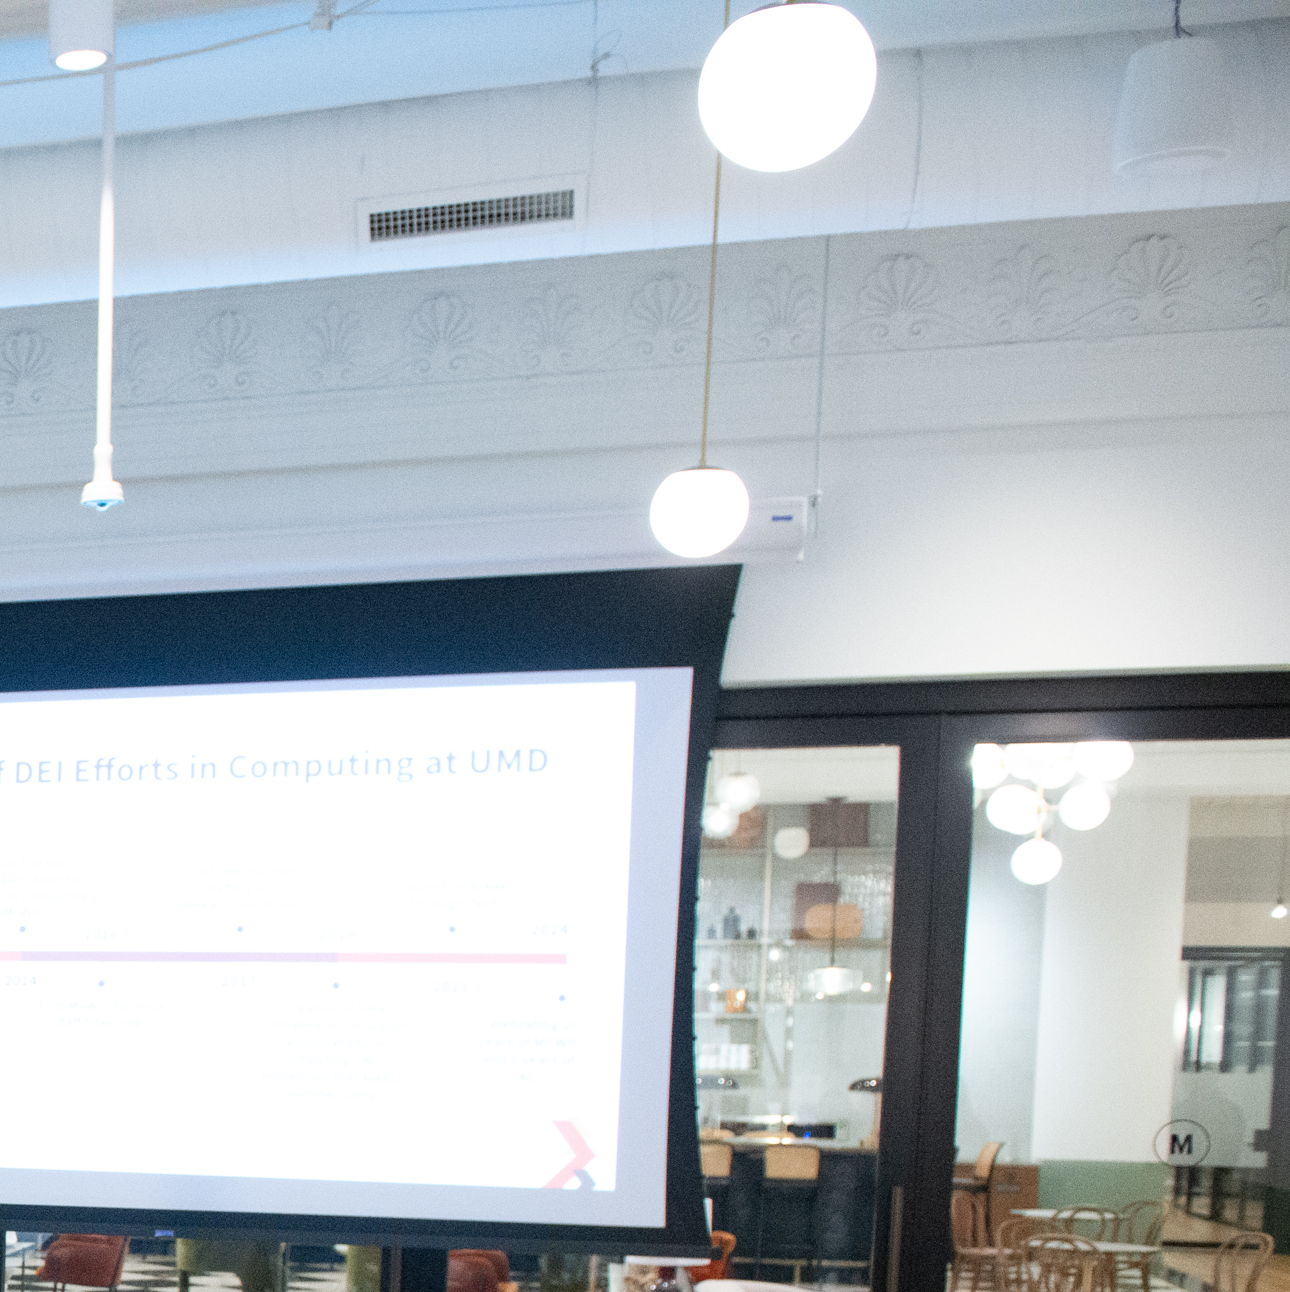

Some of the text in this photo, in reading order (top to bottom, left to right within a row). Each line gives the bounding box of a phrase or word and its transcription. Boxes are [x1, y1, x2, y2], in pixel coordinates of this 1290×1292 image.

[14, 761, 64, 786] DEI
[72, 751, 180, 784] Efforts
[189, 751, 218, 781] in
[227, 745, 415, 786] Computing
[422, 751, 459, 778] at
[467, 746, 551, 777] UMD
[4, 975, 38, 987] 2014
[1169, 1133, 1194, 1155] M
